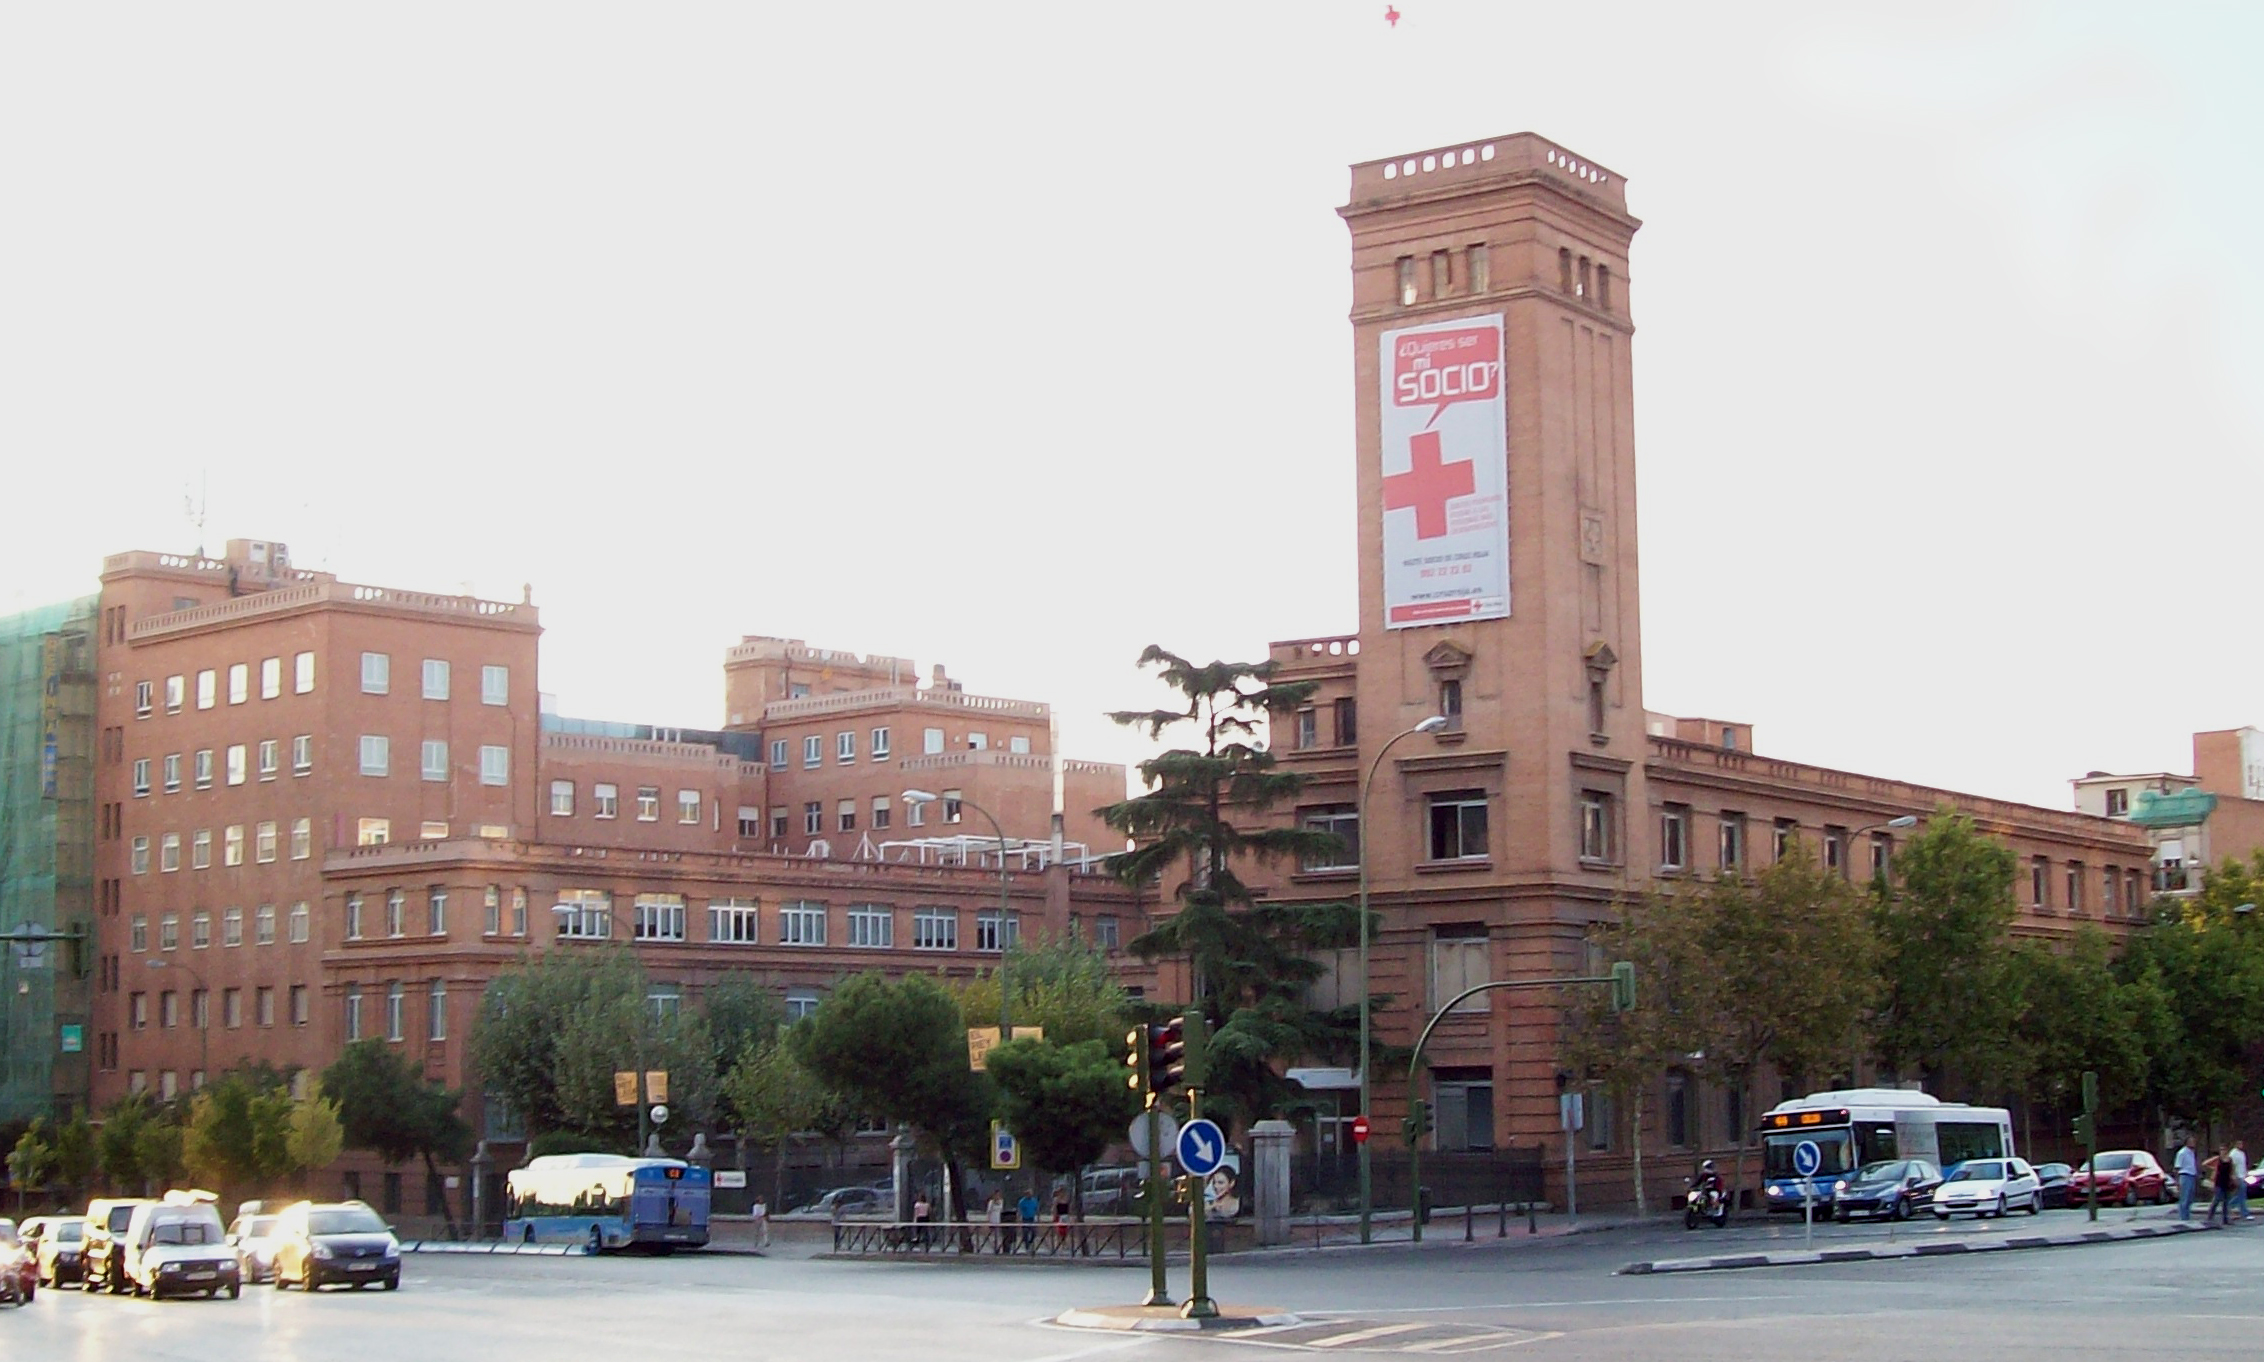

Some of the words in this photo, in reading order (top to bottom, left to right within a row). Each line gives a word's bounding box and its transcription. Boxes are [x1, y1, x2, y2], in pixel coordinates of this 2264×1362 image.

[1457, 335, 1478, 348] ser
[1413, 353, 1431, 371] mi
[1398, 361, 1498, 402] SOCIO?
